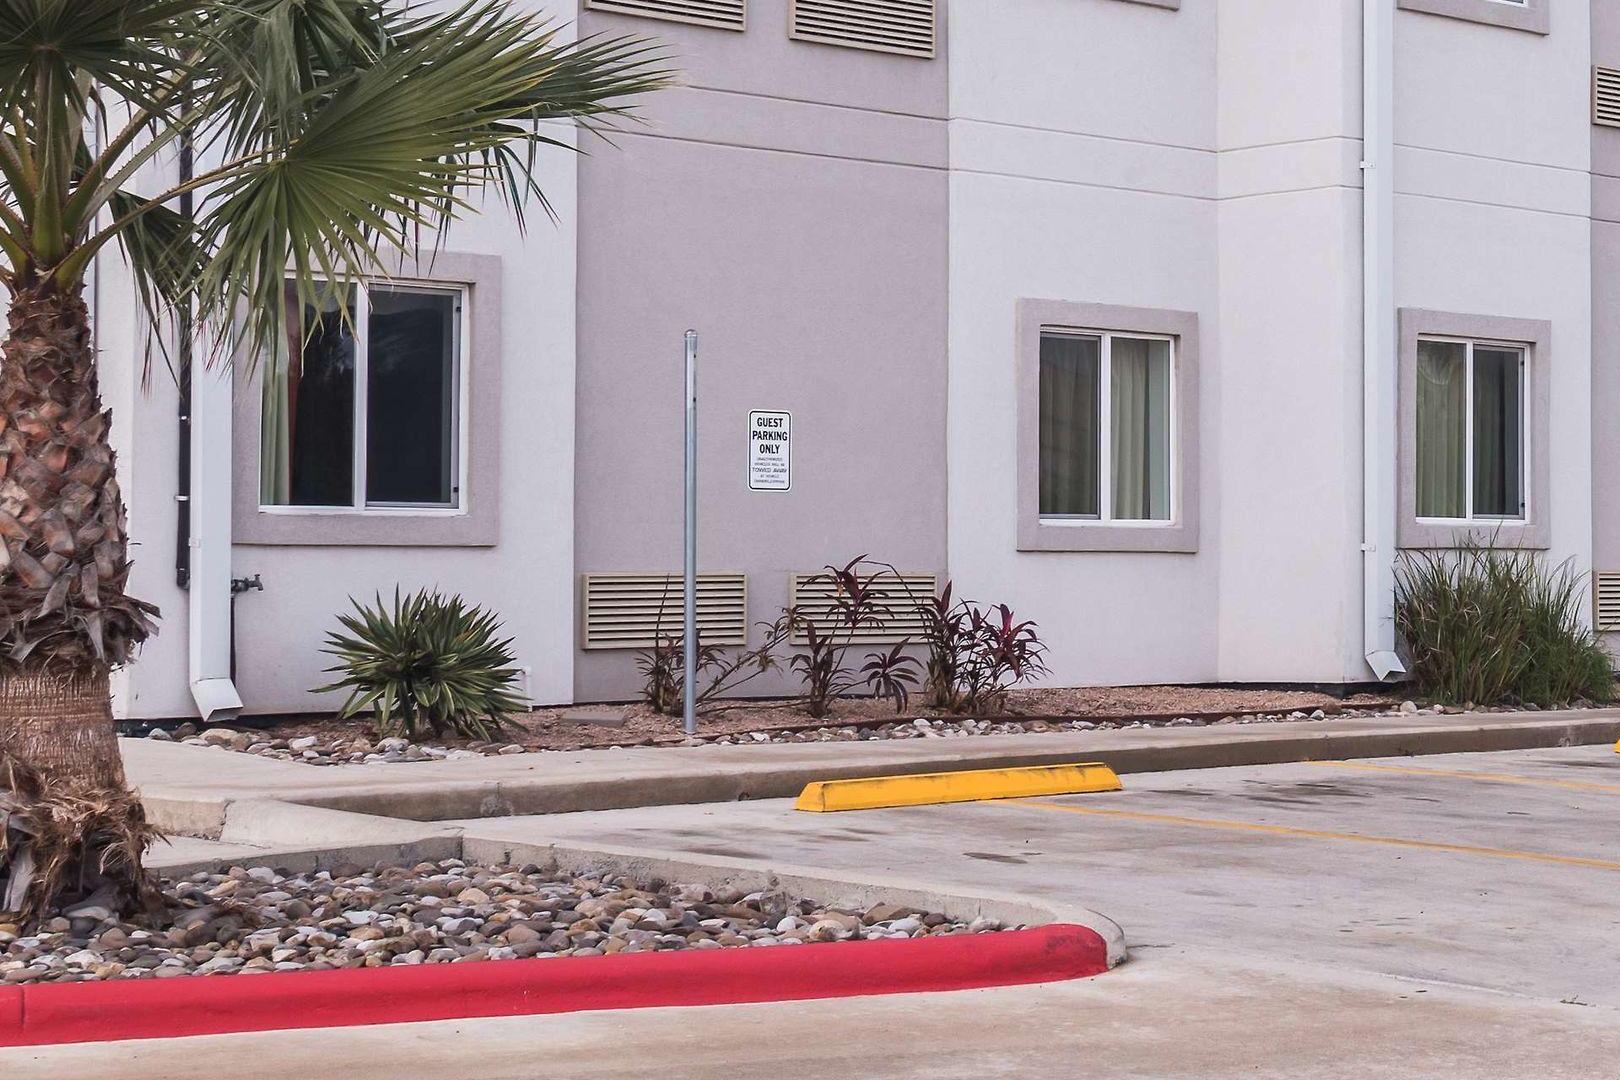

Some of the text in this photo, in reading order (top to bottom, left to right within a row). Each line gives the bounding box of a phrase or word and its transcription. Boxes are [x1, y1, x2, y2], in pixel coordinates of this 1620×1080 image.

[756, 417, 783, 428] GUEST
[752, 430, 788, 441] PARKING
[760, 444, 780, 454] ONLY
